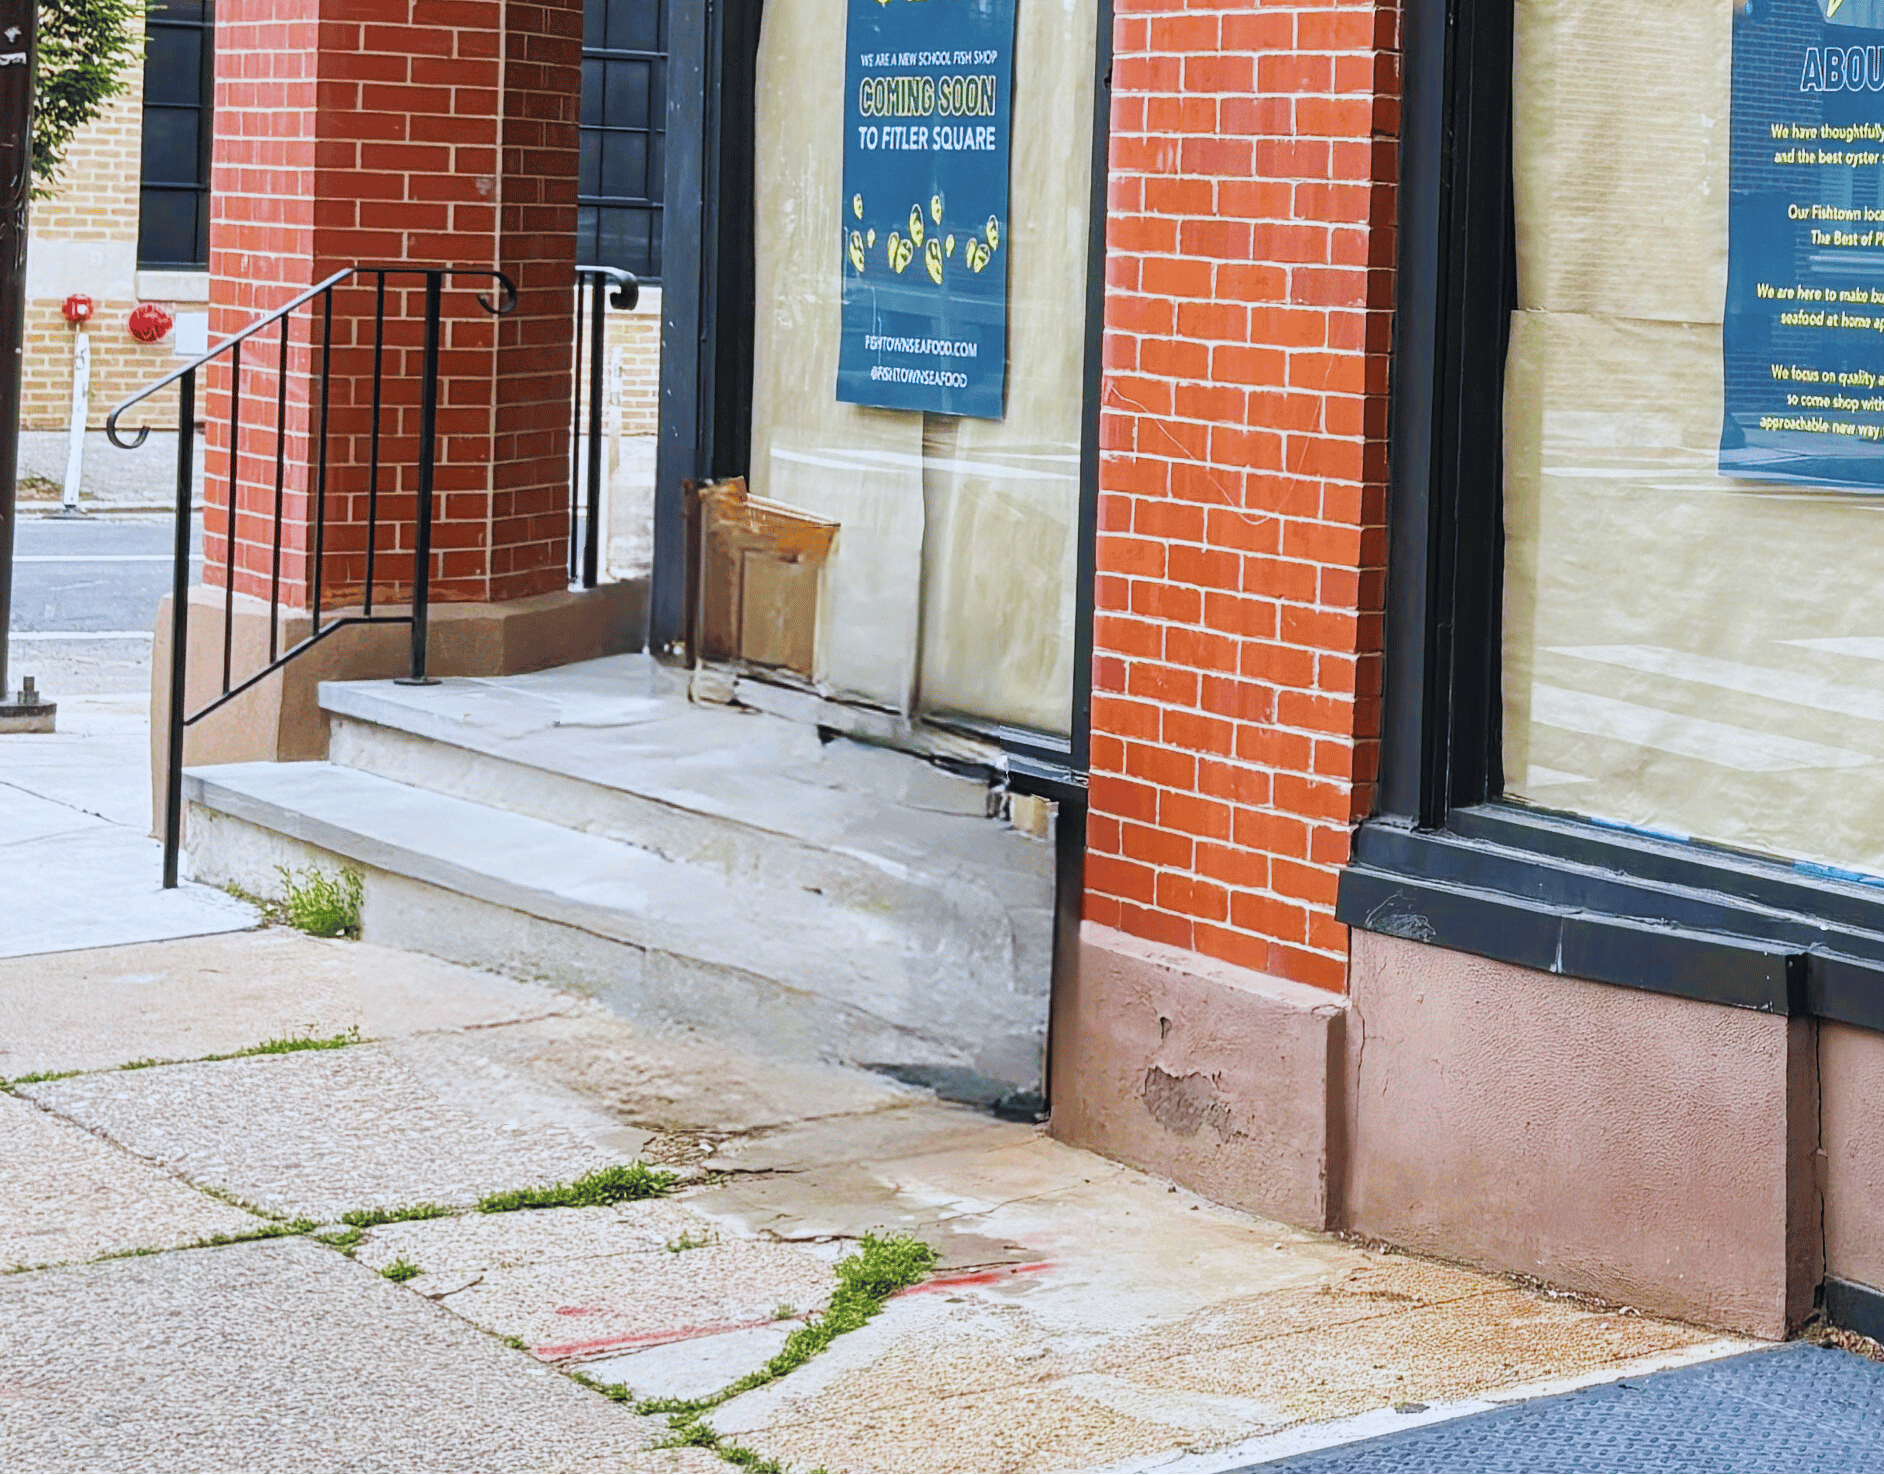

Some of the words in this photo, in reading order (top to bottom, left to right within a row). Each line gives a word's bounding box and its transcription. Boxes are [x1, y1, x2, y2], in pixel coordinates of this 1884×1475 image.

[860, 54, 874, 67] WE
[874, 53, 890, 67] ARE
[890, 53, 897, 66] A
[898, 52, 918, 66] NEW
[918, 51, 951, 66] SCHOOL
[953, 51, 972, 65] FISH
[973, 50, 998, 65] SHOP
[860, 75, 935, 117] COMING
[938, 75, 996, 117] SOON
[858, 126, 878, 149] TO
[882, 126, 928, 150] FITLER
[932, 125, 996, 151] SQUARE
[1771, 124, 1789, 138] We
[1792, 123, 1817, 139] have
[1775, 148, 1795, 164] and
[1798, 148, 1816, 163] the
[1819, 149, 1842, 164] best
[1846, 150, 1879, 168] oyster
[1788, 204, 1809, 219] Our
[1812, 205, 1861, 221] Fishtown
[1811, 230, 1831, 245] The
[1834, 230, 1858, 246] Best
[1861, 231, 1873, 246] of
[1757, 283, 1774, 299] We
[1777, 287, 1794, 300] are
[1797, 284, 1821, 301] here
[1825, 288, 1836, 301] to
[1840, 287, 1868, 303] make
[1781, 309, 1824, 326] seafood
[1827, 311, 1838, 326] at
[1842, 312, 1871, 328] home
[865, 335, 977, 357] FISHTOWNSEAFOOD.COM
[870, 366, 967, 387] @FISHTOWNSEAFOOD
[1771, 364, 1788, 379] We
[1791, 365, 1819, 382] focus
[1822, 372, 1836, 383] on
[1839, 370, 1875, 388] quality
[1787, 394, 1798, 405] so
[1801, 395, 1830, 407] come
[1833, 393, 1859, 413] shop
[1861, 397, 1884, 411] with
[1760, 416, 1829, 433] approachable
[1832, 422, 1855, 434] new
[1858, 425, 1879, 440] way
